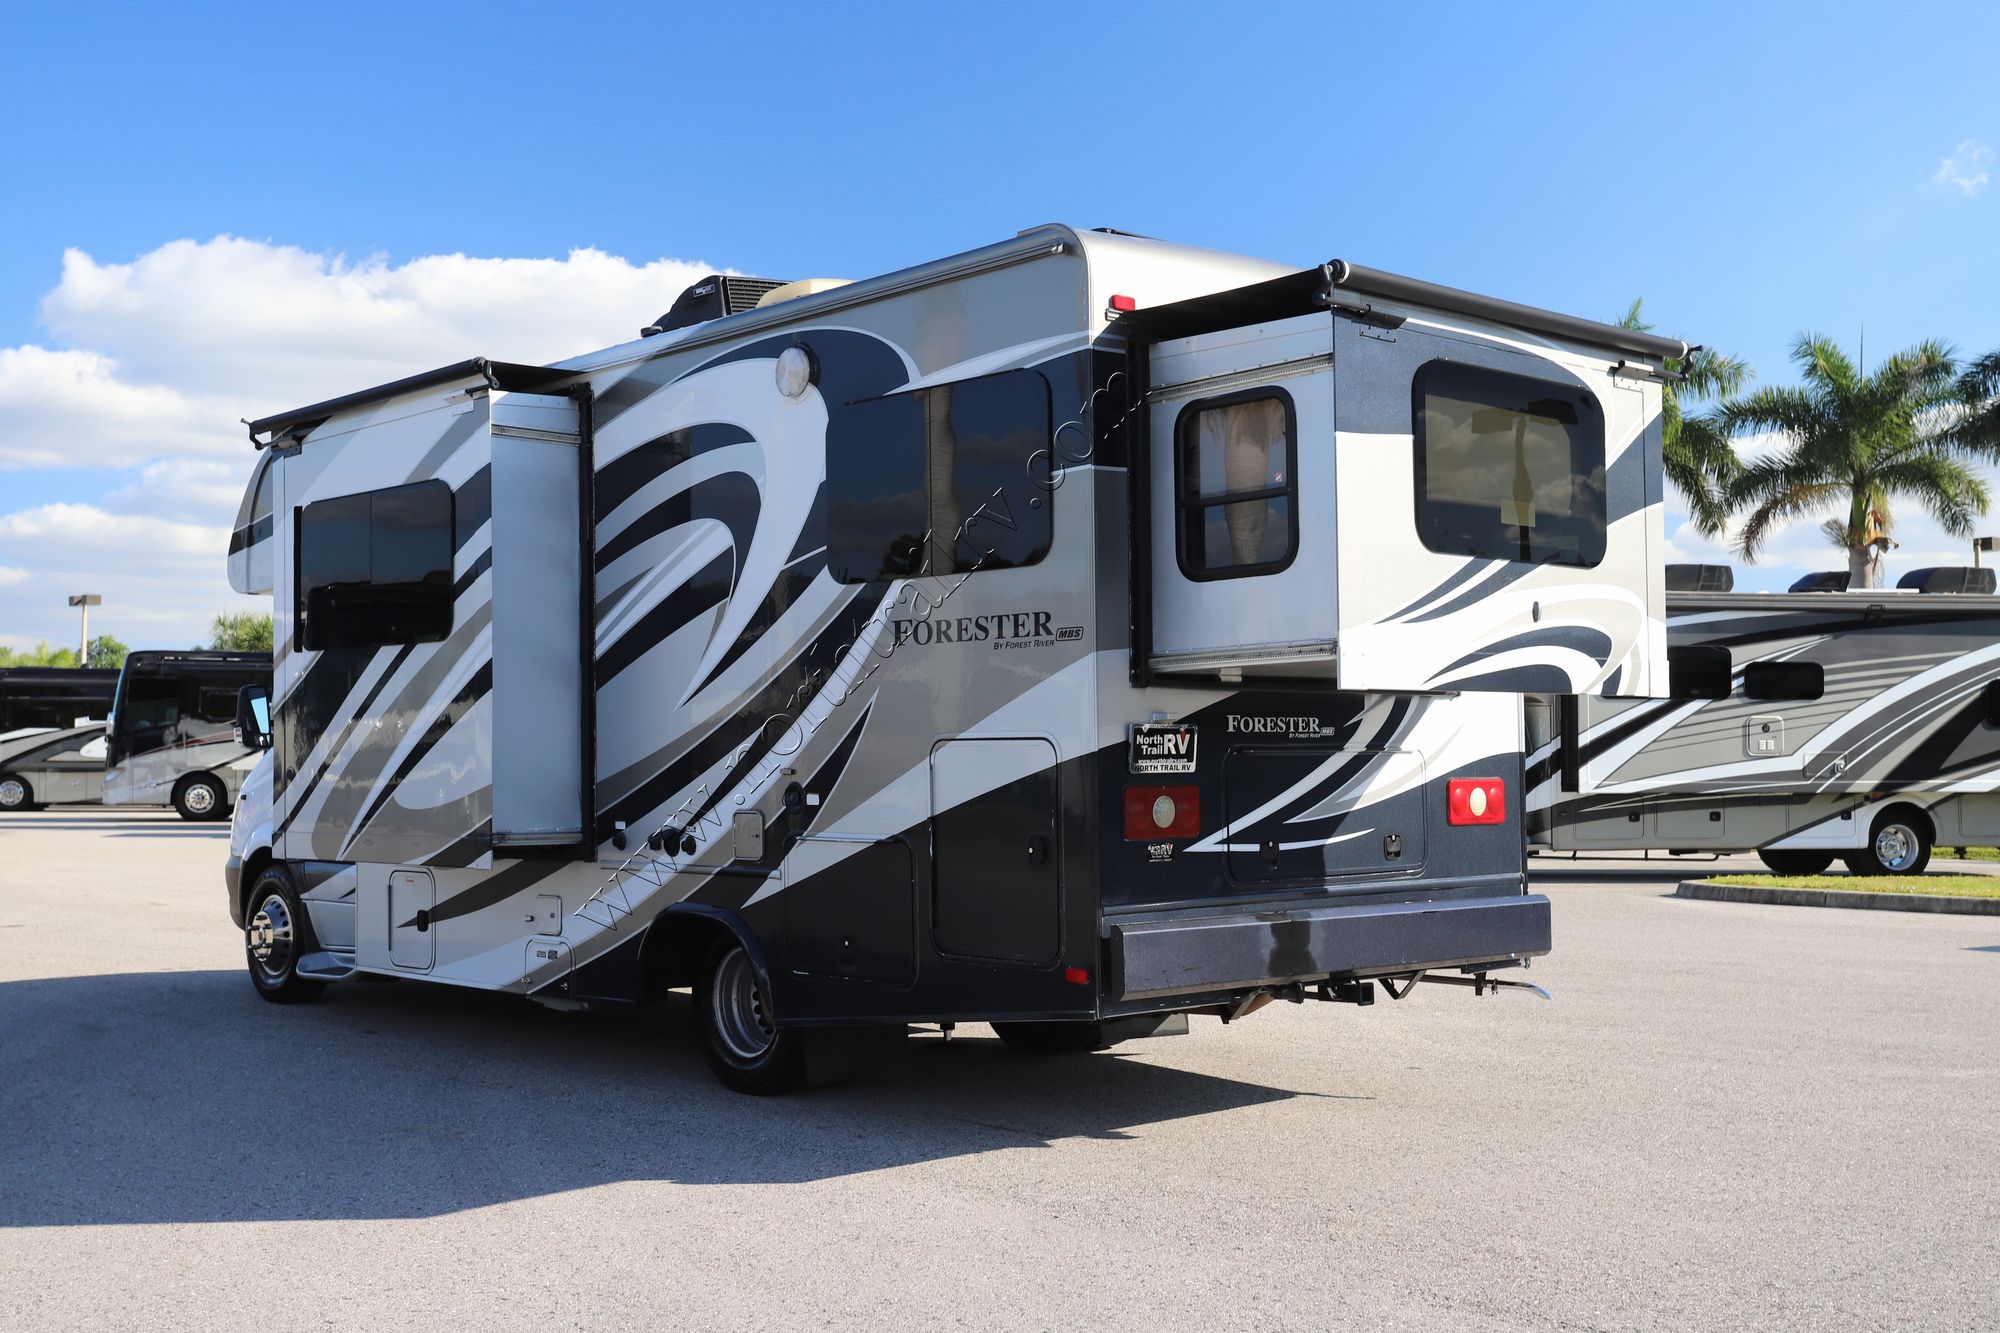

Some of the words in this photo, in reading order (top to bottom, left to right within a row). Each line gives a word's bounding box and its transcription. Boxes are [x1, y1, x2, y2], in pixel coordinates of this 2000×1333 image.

[892, 611, 1054, 647] FORESTER
[1058, 629, 1081, 639] MBS
[1005, 641, 1032, 649] FOREST
[1034, 640, 1055, 648] RIVER
[1226, 715, 1320, 732] FORESTER
[1137, 734, 1163, 745] North
[1164, 734, 1190, 754] RV
[1141, 745, 1163, 755] Trail
